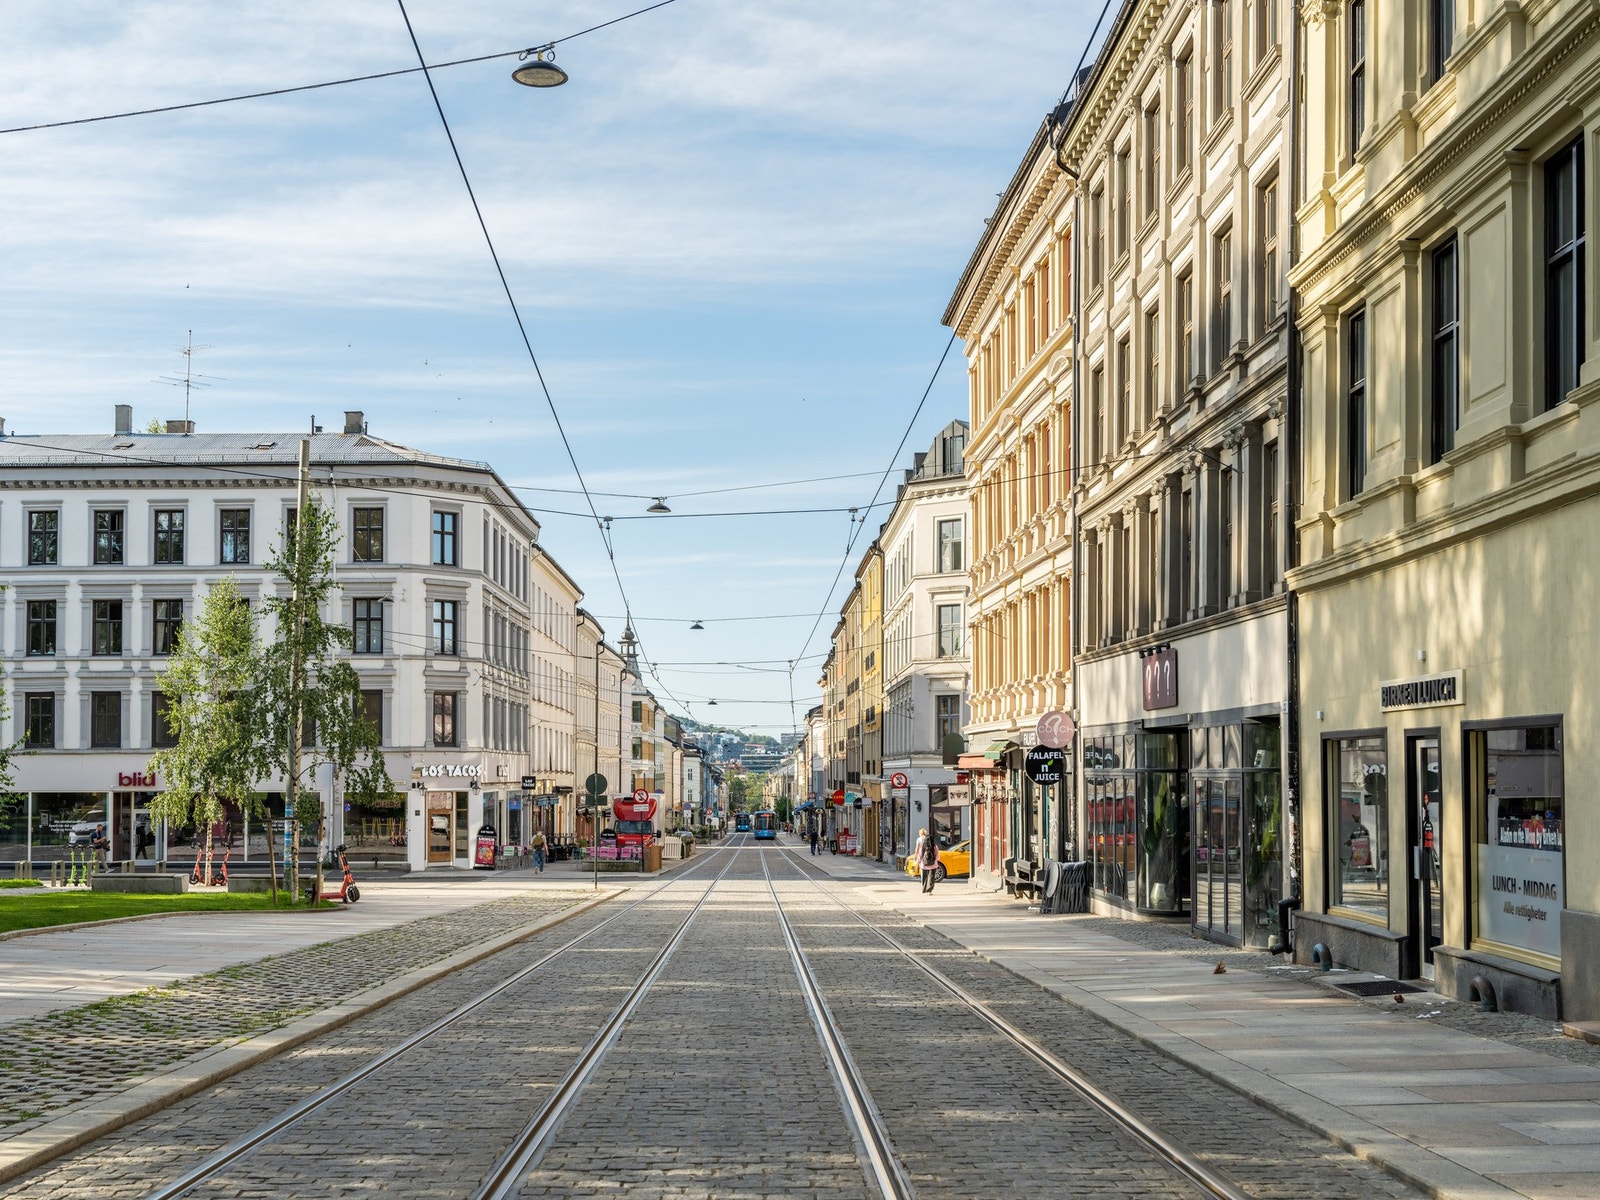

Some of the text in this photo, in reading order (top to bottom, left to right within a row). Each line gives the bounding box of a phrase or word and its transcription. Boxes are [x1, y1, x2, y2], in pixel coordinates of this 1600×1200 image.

[1381, 677, 1456, 707] BIRKEN LUNCH
[1028, 751, 1064, 760] FALAFEL
[421, 764, 484, 777] LOS TACOS
[1034, 773, 1060, 781] JUICE
[1492, 875, 1517, 894] LUNCH
[1523, 880, 1557, 901] MIDDAG
[1503, 901, 1547, 921] Alle rettigheter
